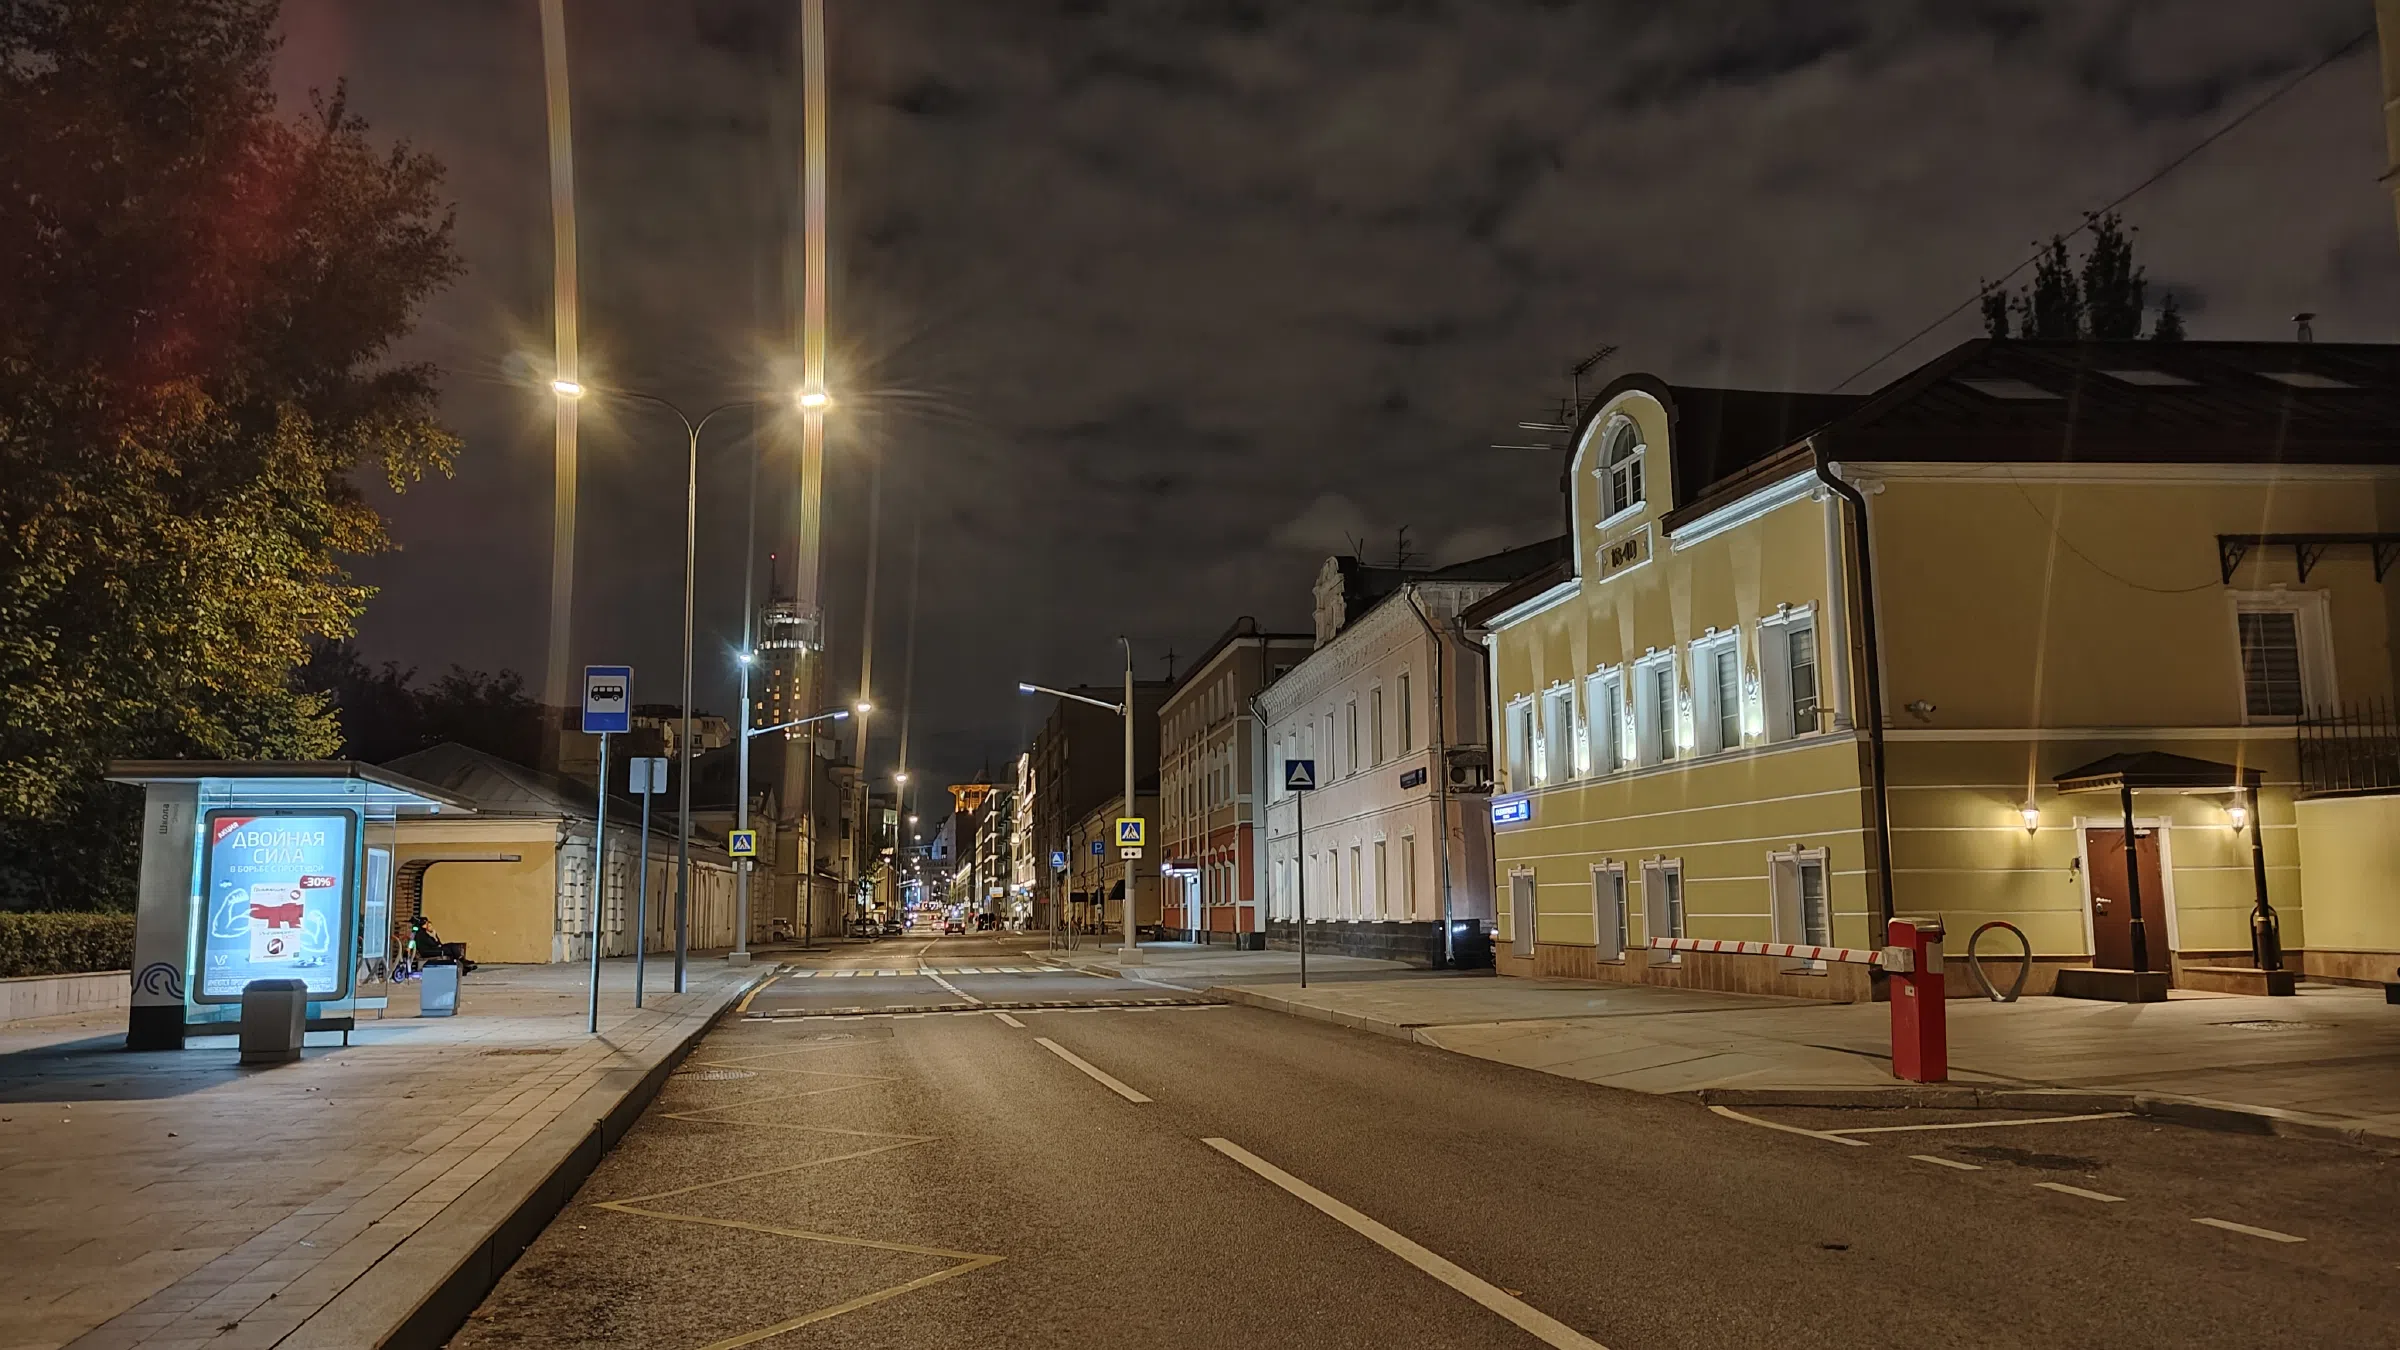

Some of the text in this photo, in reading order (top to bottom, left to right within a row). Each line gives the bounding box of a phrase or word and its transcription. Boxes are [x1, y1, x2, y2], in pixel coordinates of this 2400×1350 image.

[1611, 540, 1637, 568] 1840
[159, 803, 170, 835] Школа
[218, 822, 239, 839] АКЦИЯ
[232, 828, 325, 849] ДВОЙНАЯ
[253, 849, 304, 863] СИЛА
[230, 864, 324, 873] В БОРЬБЕ С ПРОСТУДОЙ
